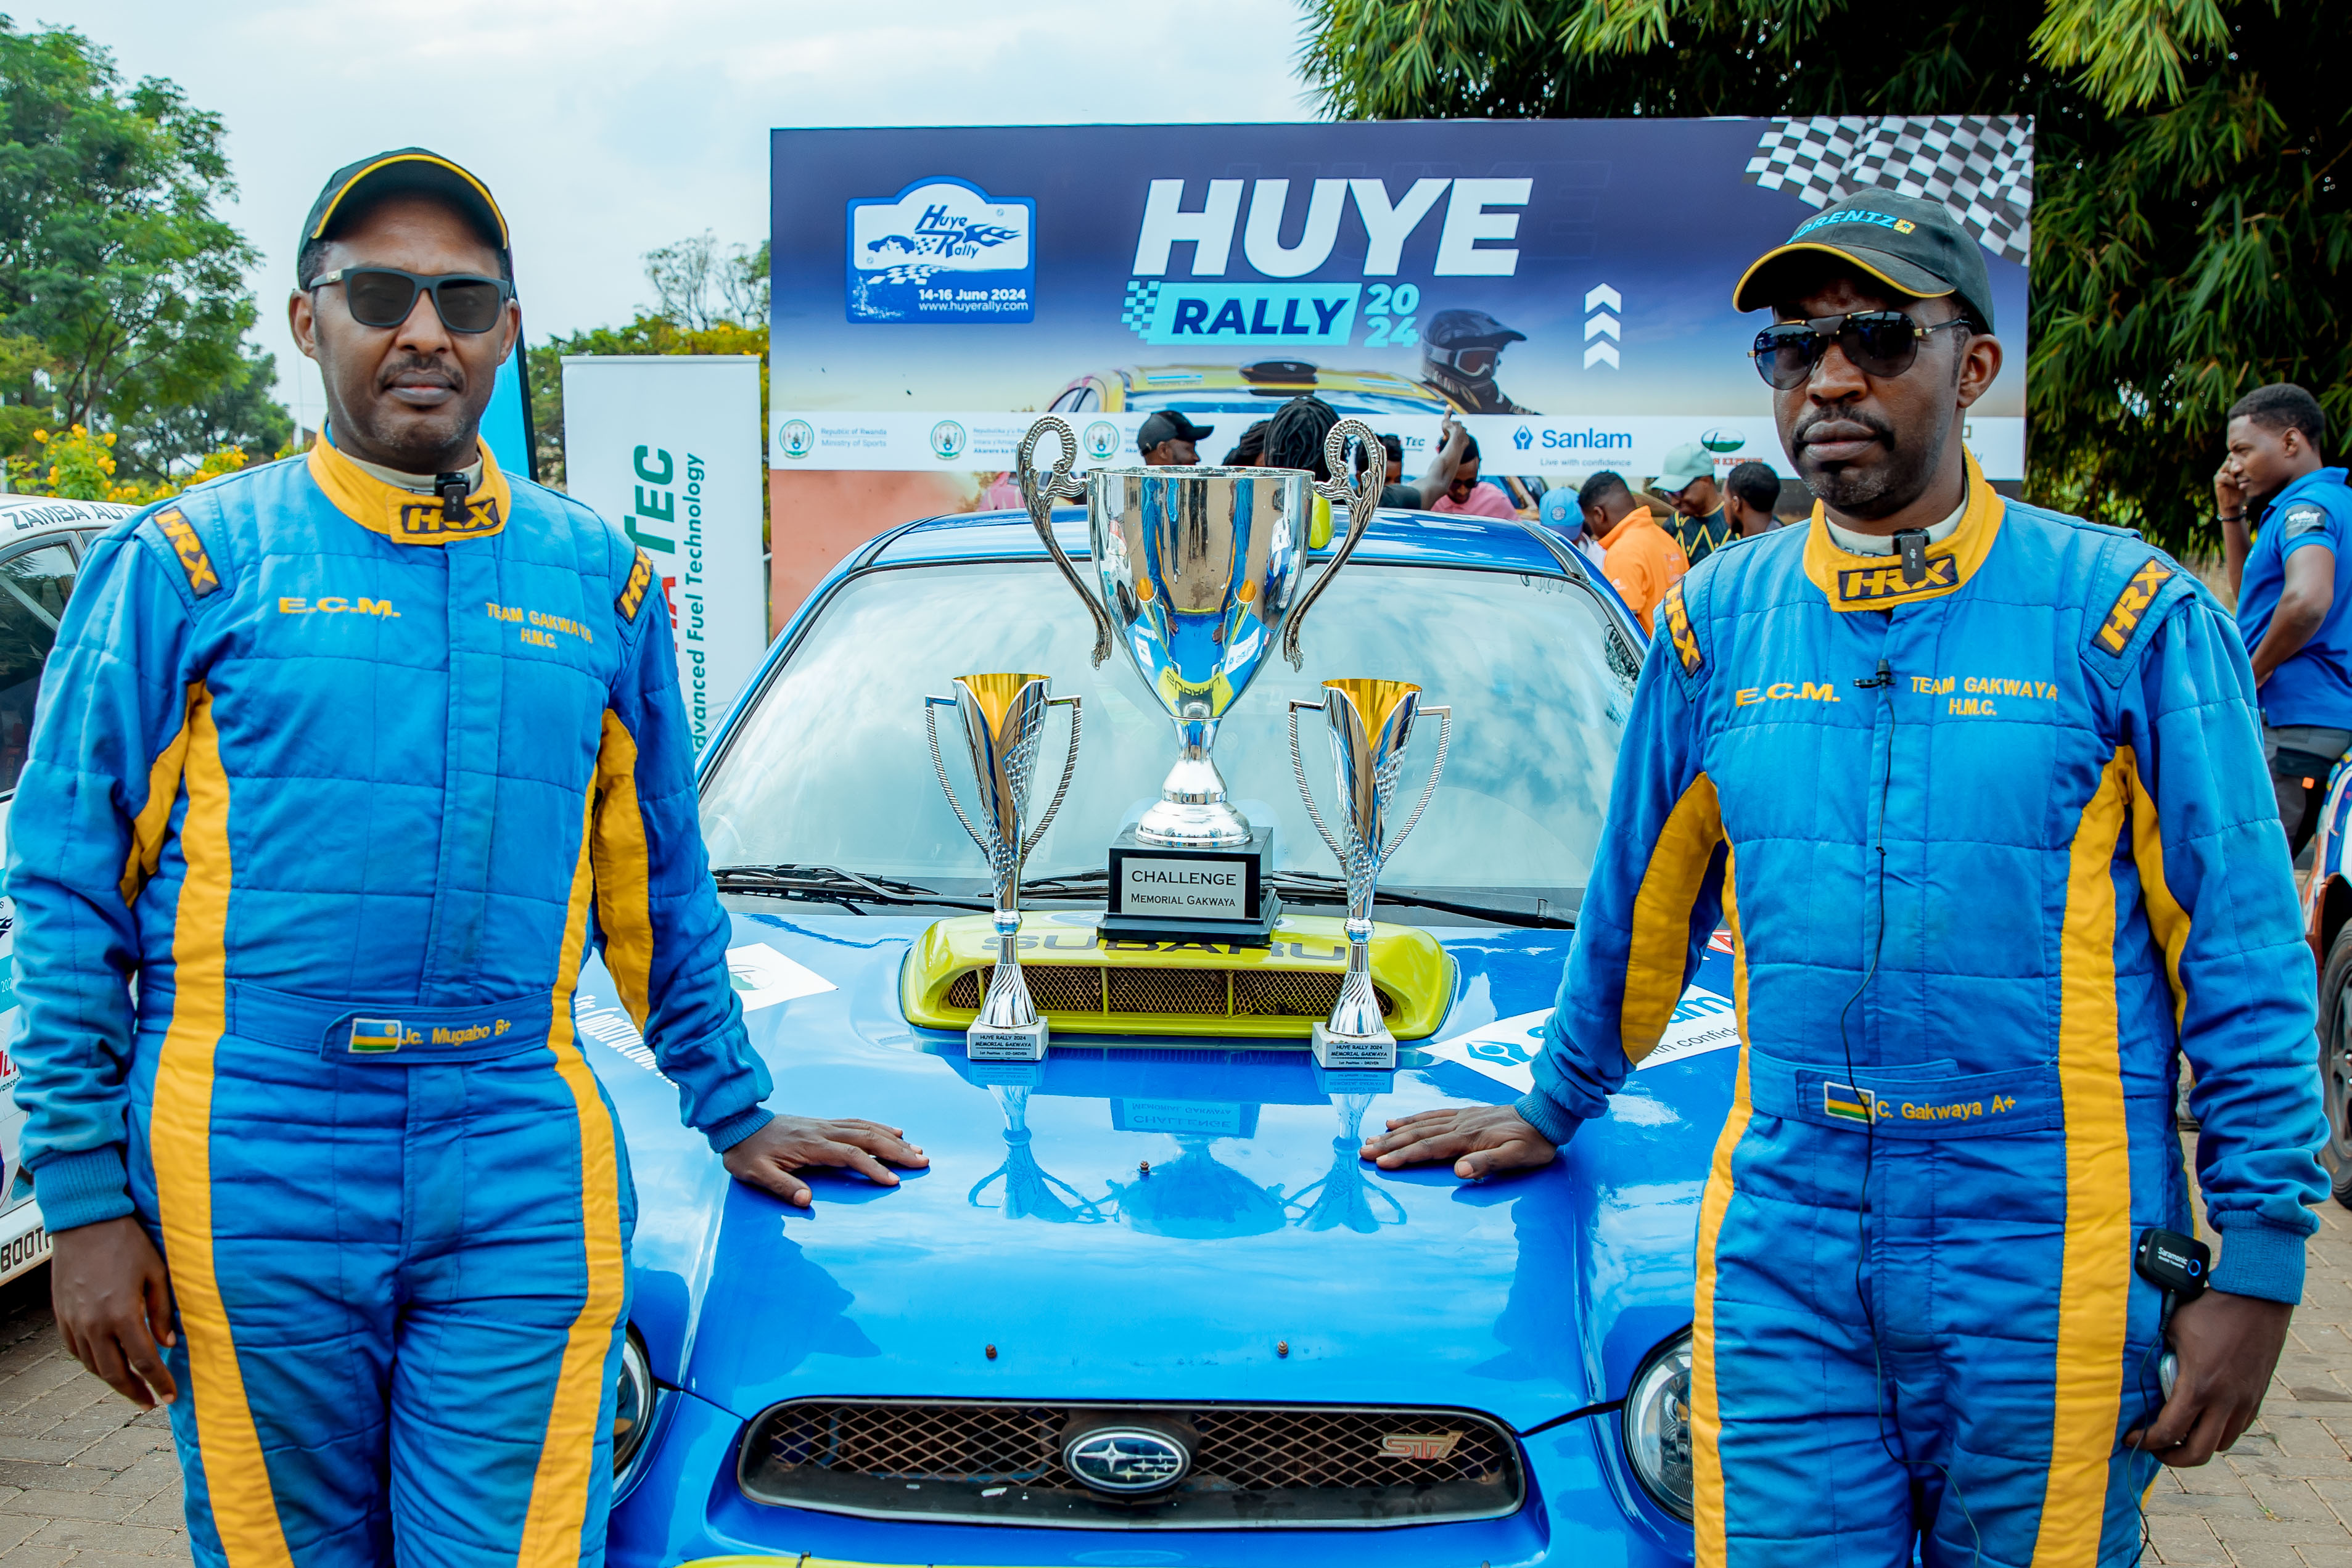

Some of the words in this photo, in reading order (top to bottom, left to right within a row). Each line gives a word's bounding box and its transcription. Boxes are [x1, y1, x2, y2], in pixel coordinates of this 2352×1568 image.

[915, 205, 968, 230] Huye
[1132, 178, 1534, 277] HUYE
[915, 230, 979, 258] Rally
[919, 289, 952, 300] 14-16
[956, 289, 988, 300] June
[991, 289, 1026, 300] 2024
[919, 301, 1029, 313] www.huyerally.com
[1364, 282, 1420, 316] 20
[1171, 299, 1349, 334] RALLY
[1363, 316, 1420, 348] 24
[821, 439, 850, 448] Ministry
[853, 439, 860, 447] of
[863, 440, 887, 448] Sports
[1405, 437, 1425, 446] TEC
[1542, 428, 1632, 448] Sanlam
[1540, 459, 1559, 467] Live
[1561, 458, 1579, 467] with
[1582, 458, 1631, 467] confidence
[624, 445, 675, 554] TEC
[1, 504, 91, 530] ZAMBA
[683, 453, 705, 585] Technology
[155, 511, 218, 589] HRX
[279, 596, 401, 617] E.C.M.
[486, 602, 524, 622] TEAM
[685, 593, 704, 641] Fuel
[2100, 560, 2171, 651] HRX
[1665, 583, 1700, 667] HRX
[1735, 681, 1841, 707] E.C.M.
[1910, 676, 1955, 696] TEAM
[1964, 676, 2058, 702] GAKWAYA
[686, 649, 706, 756] dvanced
[1948, 699, 1997, 716] H.M.C.
[1131, 870, 1236, 886] CHALLENGE
[401, 1027, 423, 1045] Jc.
[432, 1024, 491, 1047] Mugabo
[495, 1019, 511, 1036] B+
[1877, 1100, 1894, 1119] C.
[1901, 1101, 1982, 1121] Gakwaya
[1991, 1094, 2016, 1114] A+
[2158, 1247, 2189, 1265] Saramonic
